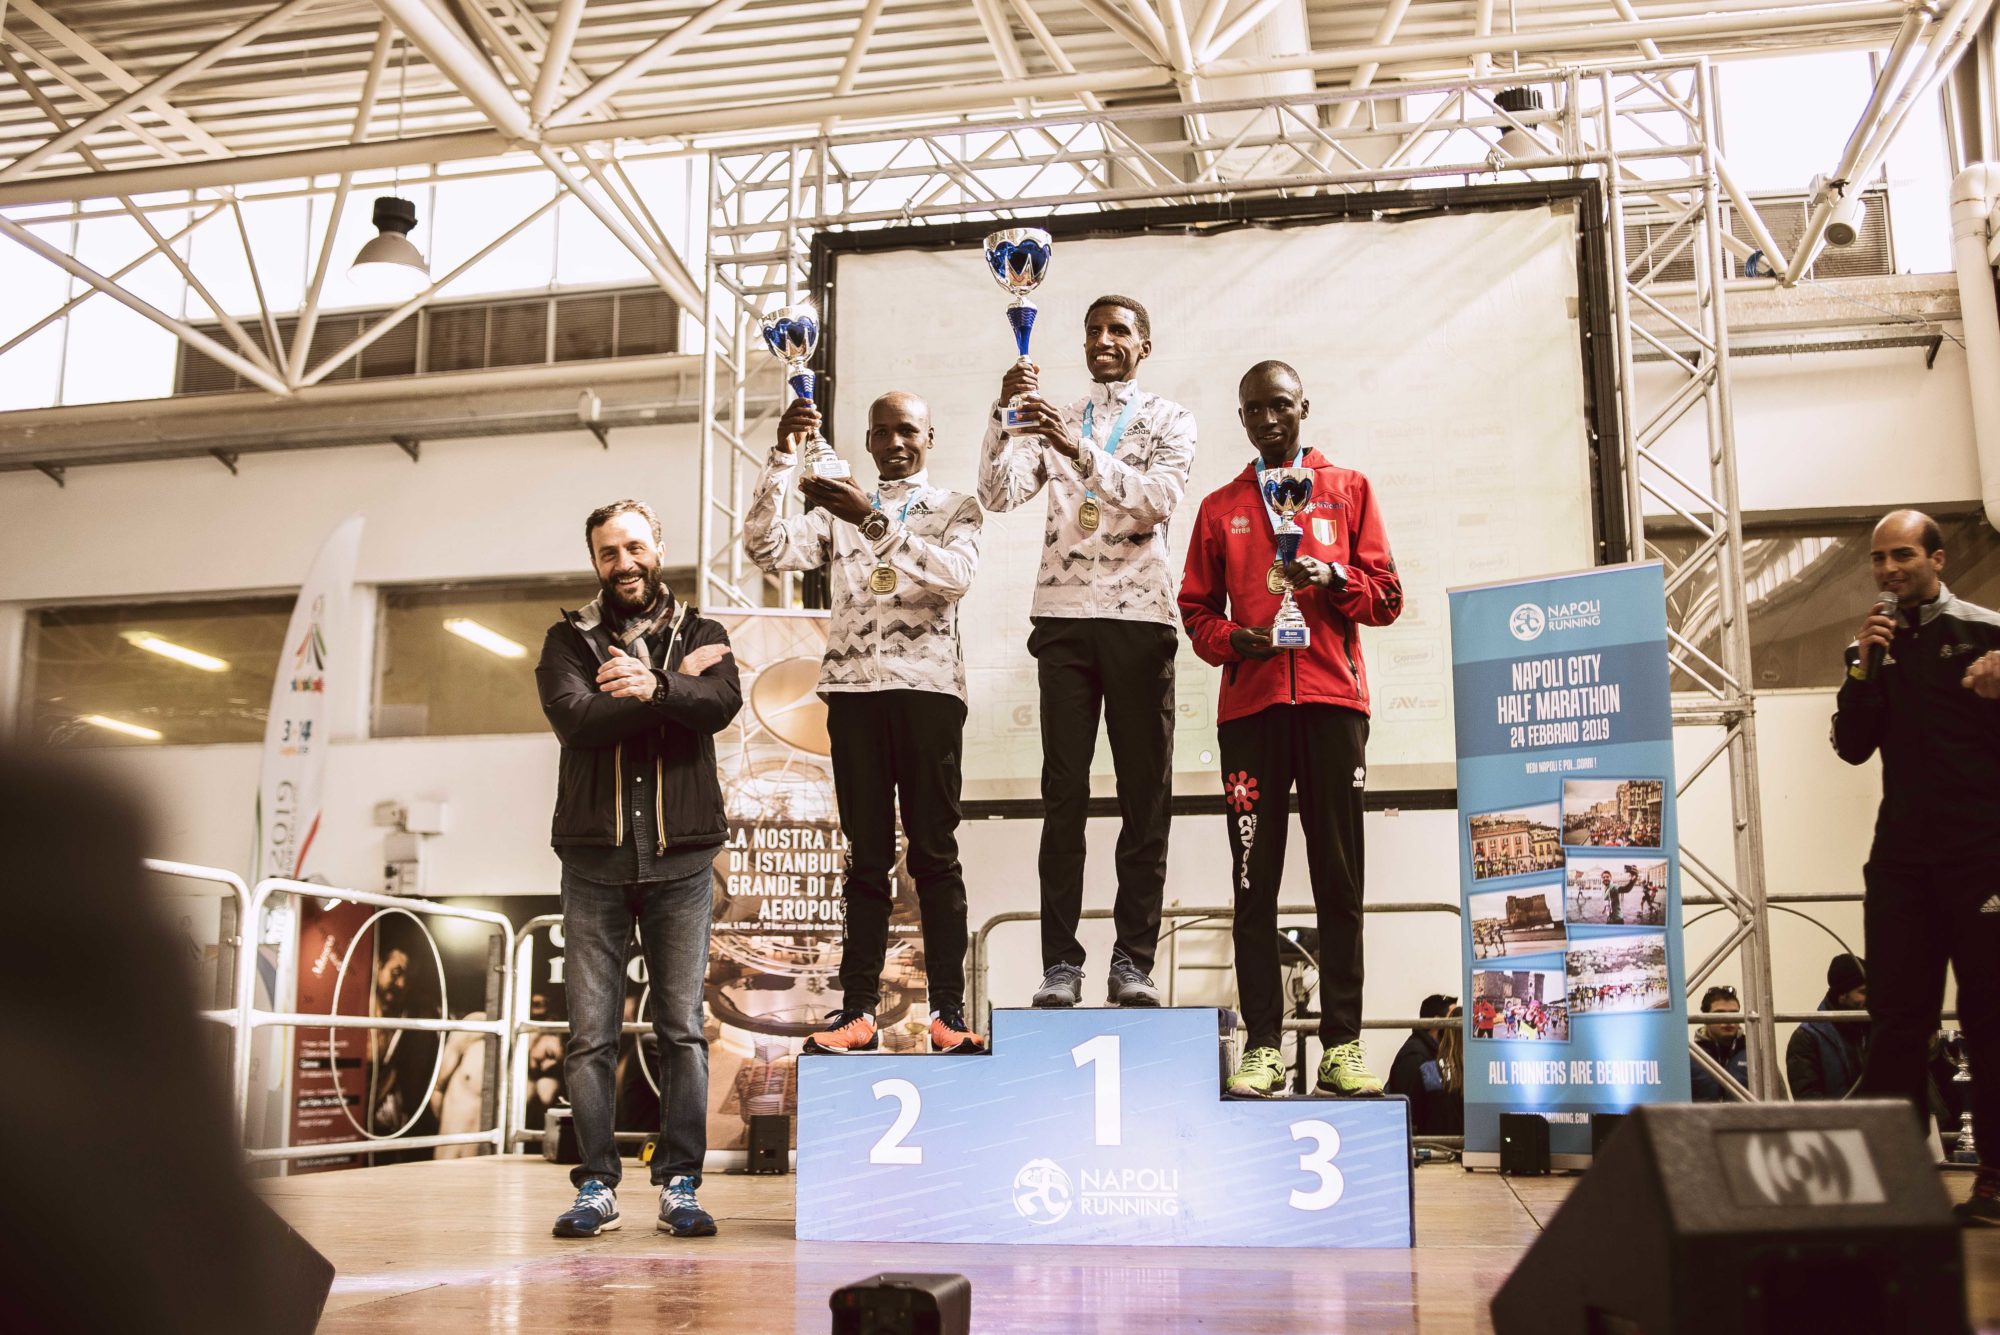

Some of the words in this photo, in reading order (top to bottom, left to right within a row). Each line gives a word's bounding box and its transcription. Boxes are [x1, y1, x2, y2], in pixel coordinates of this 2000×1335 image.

[1124, 429, 1150, 437] adidas
[1548, 599, 1600, 617] NAPOLI
[1548, 615, 1600, 631] RUNNING
[1512, 657, 1563, 691] NAPOLI
[1568, 654, 1601, 685] CITY
[1497, 695, 1531, 724] HALF
[1536, 684, 1620, 720] MARATHON
[1510, 728, 1525, 748] 24
[1528, 721, 1579, 746] FEBBRAIO
[1582, 718, 1610, 742] 2019
[1539, 760, 1558, 773] NAPOLI
[725, 828, 748, 849] LA
[754, 828, 825, 849] NOSTRA
[730, 852, 748, 872] DI
[755, 852, 843, 873] ISTANBUL
[727, 875, 800, 897] GRANDE
[807, 876, 825, 897] DI
[759, 899, 844, 921] AEROPOR
[1489, 1060, 1508, 1085] ALL
[1511, 1060, 1566, 1085] RUNNERS
[1570, 1060, 1593, 1085] ARE
[1597, 1060, 1661, 1085] BEAUTIFUL
[1071, 1035, 1121, 1146] 1
[869, 1078, 923, 1165] 2
[1288, 1119, 1345, 1211] 3
[1081, 1168, 1178, 1191] NAPOLI
[1081, 1198, 1178, 1217] RUNNING
